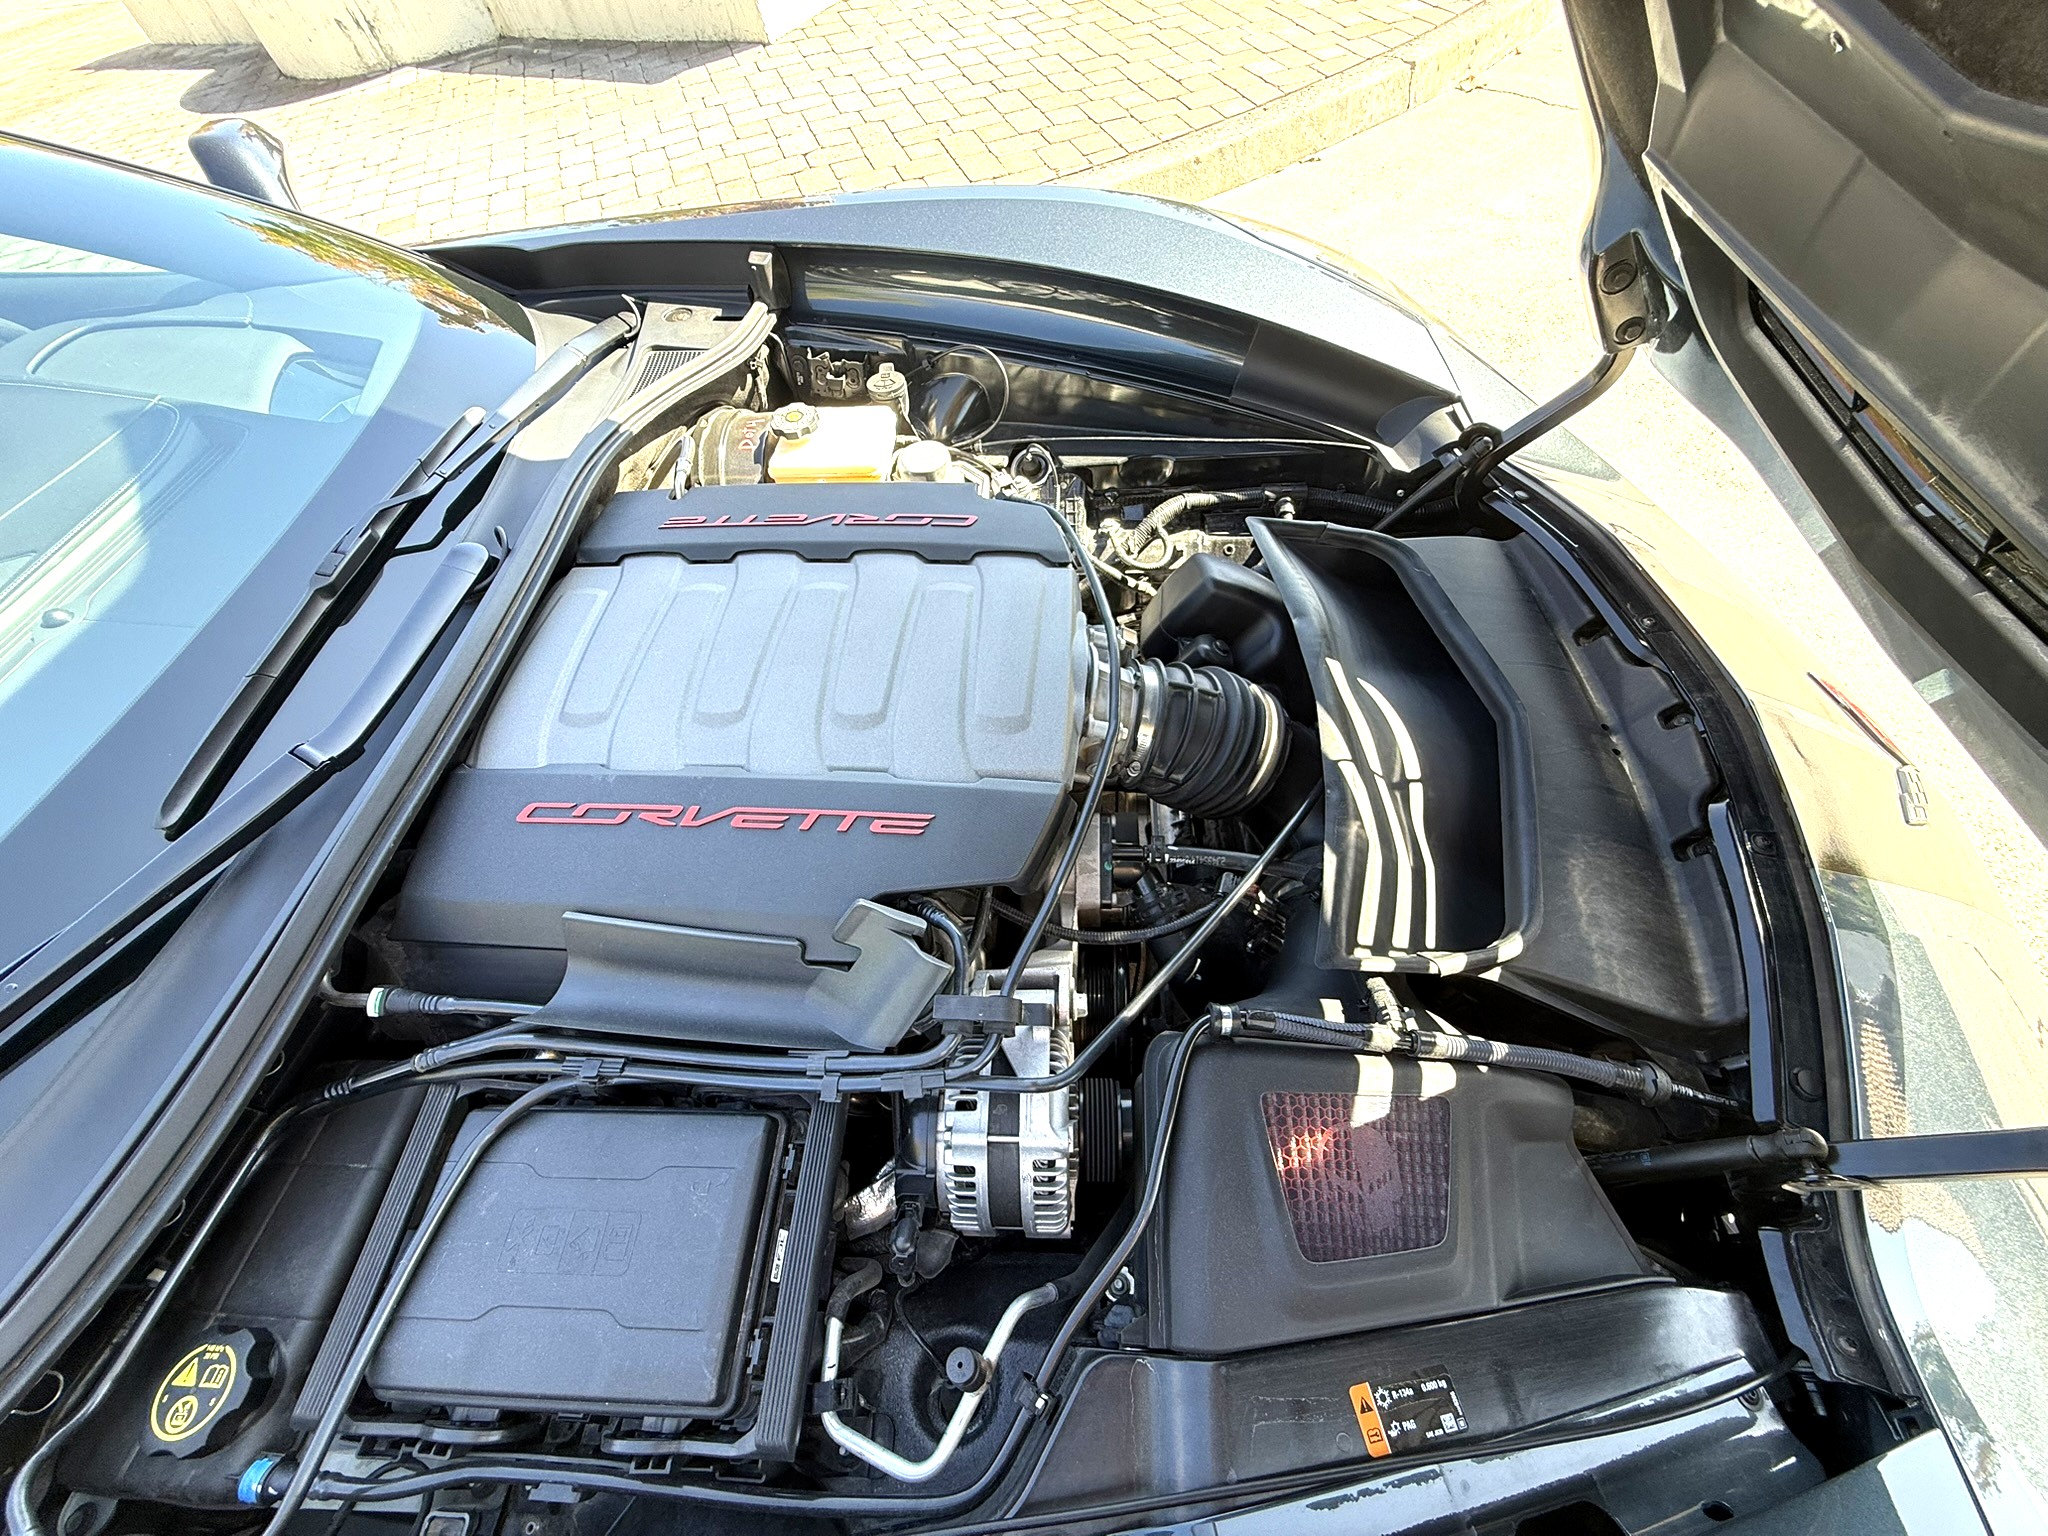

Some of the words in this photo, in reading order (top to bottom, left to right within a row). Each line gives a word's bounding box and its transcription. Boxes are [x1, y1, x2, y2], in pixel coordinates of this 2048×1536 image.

[658, 513, 979, 529] CORVETTE
[515, 802, 936, 835] CORVETTE
[1391, 1388, 1414, 1399] R-134a
[1401, 1419, 1417, 1431] PAG
